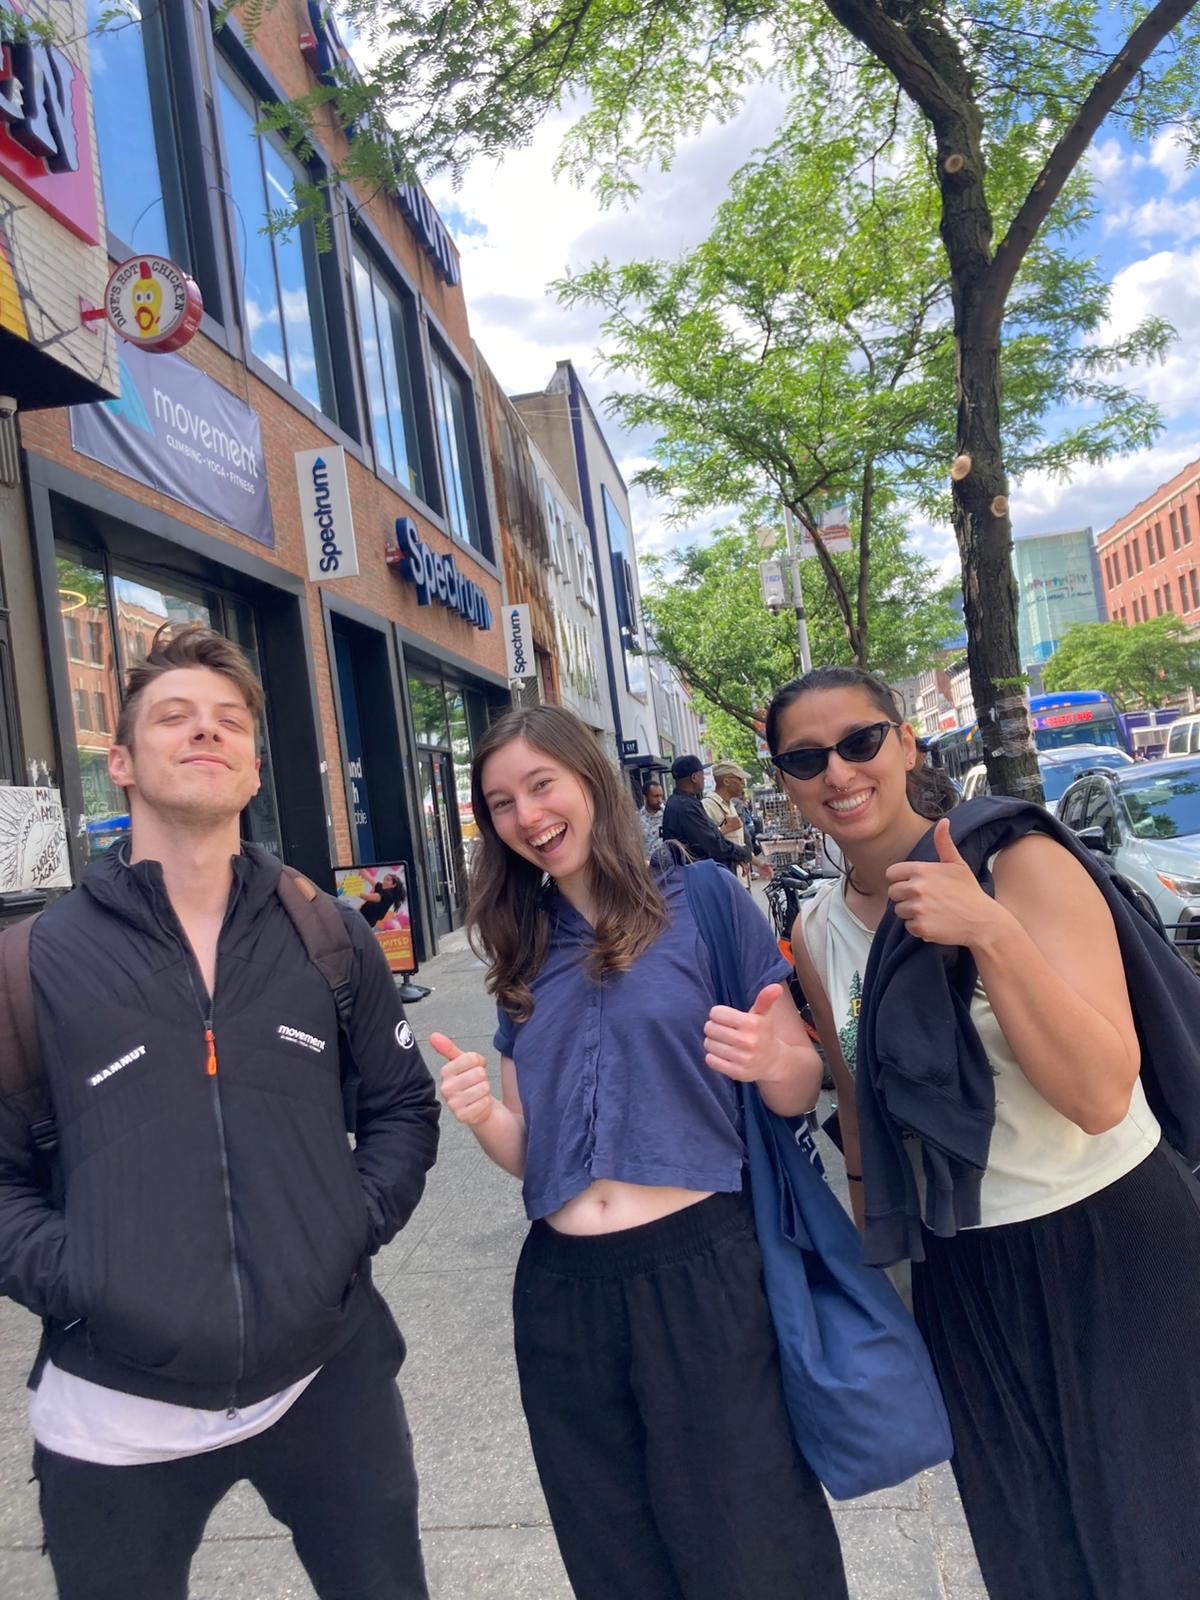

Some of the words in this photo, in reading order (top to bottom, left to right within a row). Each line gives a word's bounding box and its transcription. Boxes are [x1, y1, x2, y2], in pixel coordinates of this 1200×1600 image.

[116, 263, 139, 286] HOT
[151, 261, 186, 312] CHICKEN
[110, 285, 128, 328] DAVE'S
[152, 387, 259, 479] movement
[166, 433, 203, 464] CLIMBING
[206, 457, 227, 478] YOGA
[229, 471, 256, 495] FITNESS
[312, 461, 343, 573] Spectrum
[400, 517, 491, 628] Spectrum
[510, 612, 527, 674] Spectrum
[278, 1024, 326, 1050] movement
[90, 1045, 146, 1086] MAMMUT
